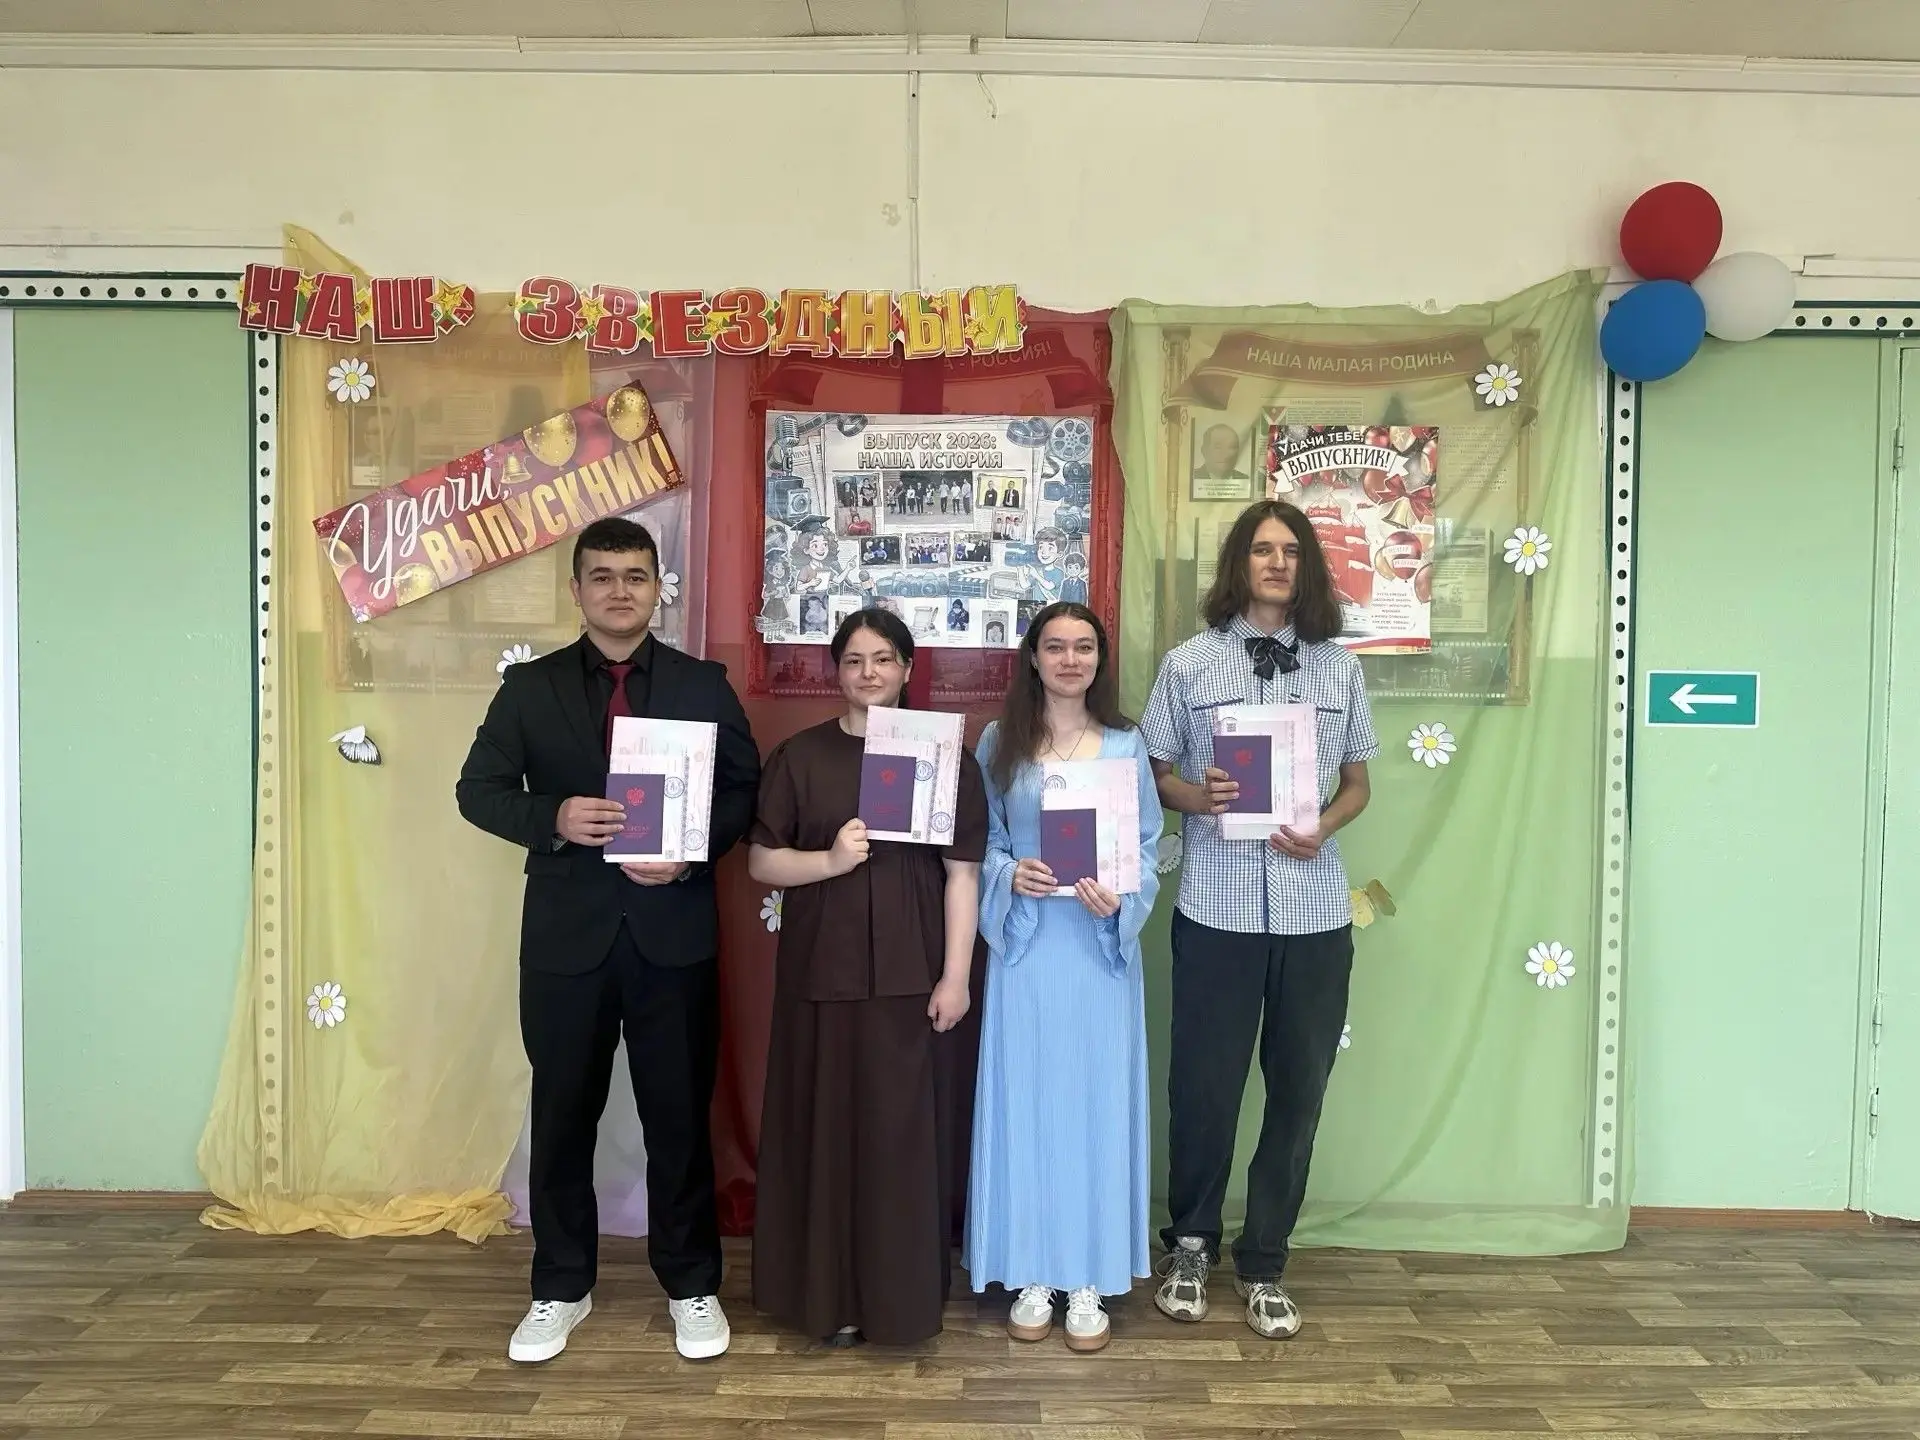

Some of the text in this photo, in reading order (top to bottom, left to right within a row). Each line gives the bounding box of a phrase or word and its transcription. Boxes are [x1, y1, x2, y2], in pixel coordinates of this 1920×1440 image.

[239, 263, 1023, 359] НАШ ЗВЕЗДНЫЙ
[971, 340, 1053, 369] РОССИЯ!
[1247, 347, 1455, 372] НАША МАЛАЯ РОДИНА
[863, 432, 997, 450] ВЫПУСК 2026:
[1278, 431, 1364, 456] УДАЧИ ТЕБЕ,
[858, 451, 1003, 469] НАША ИСТОРИЯ
[1287, 447, 1392, 477] ВЫПУСКНИК!
[420, 433, 677, 584] ВЫПУСКНИК!
[328, 467, 512, 599] Удачи,
